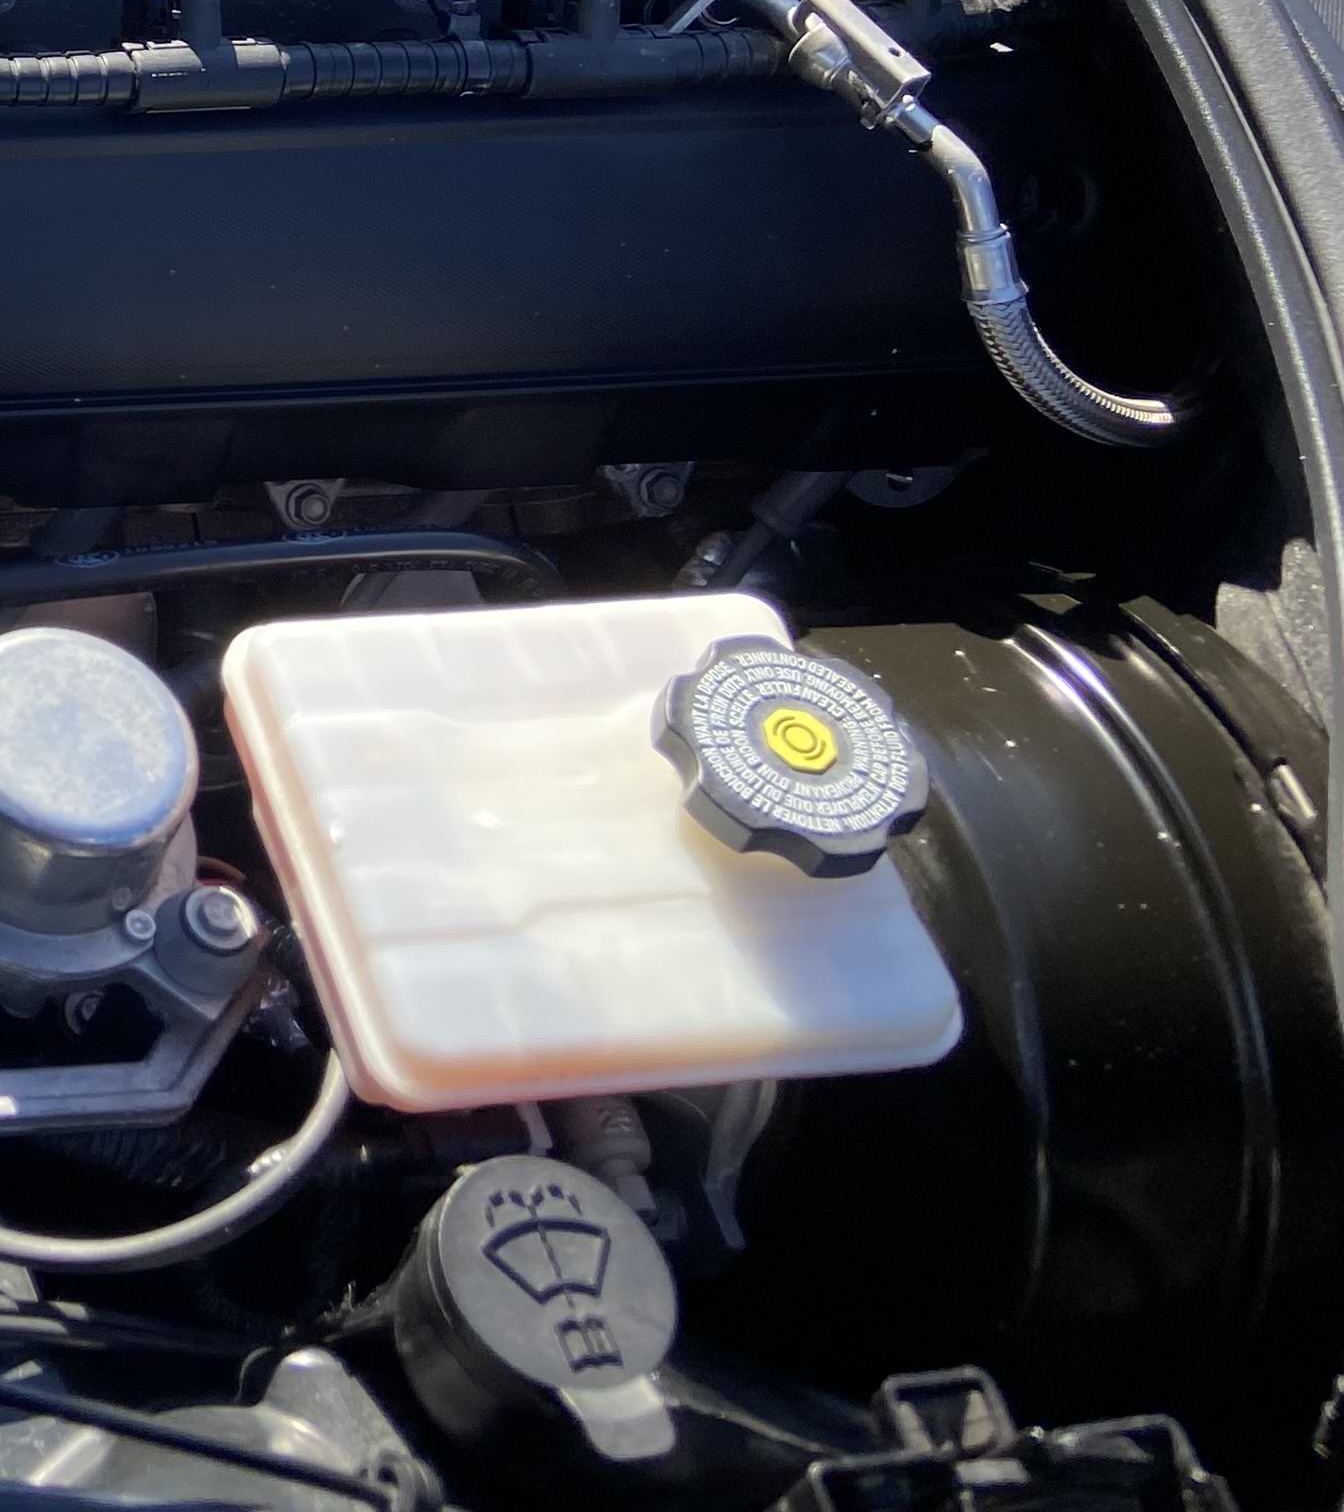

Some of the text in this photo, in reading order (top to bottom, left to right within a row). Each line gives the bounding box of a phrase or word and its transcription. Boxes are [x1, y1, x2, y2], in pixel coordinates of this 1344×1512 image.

[717, 674, 746, 700] DOT3
[744, 666, 774, 682] ONLY
[776, 668, 801, 681] USE
[808, 661, 857, 693] SEALED
[692, 694, 710, 709] LA
[755, 681, 801, 697] FILLER
[801, 685, 845, 718] CLEAN
[852, 688, 866, 700] A
[709, 695, 729, 727] FREIN
[860, 698, 895, 730] FROM
[691, 709, 714, 746] AVANT
[712, 729, 731, 744] DE
[860, 718, 889, 763] BEFORE
[730, 729, 761, 766] BIDON
[882, 730, 907, 763] FLUID
[701, 747, 754, 800] BOUCHON
[719, 746, 765, 791] LIQUIDE
[870, 762, 888, 784] CAP
[888, 763, 909, 793] DOT3
[762, 783, 783, 802] DU
[793, 771, 864, 799] PROVENANT
[750, 793, 774, 813] LE
[784, 794, 813, 813] QUE
[772, 804, 842, 832] NETTOYER
